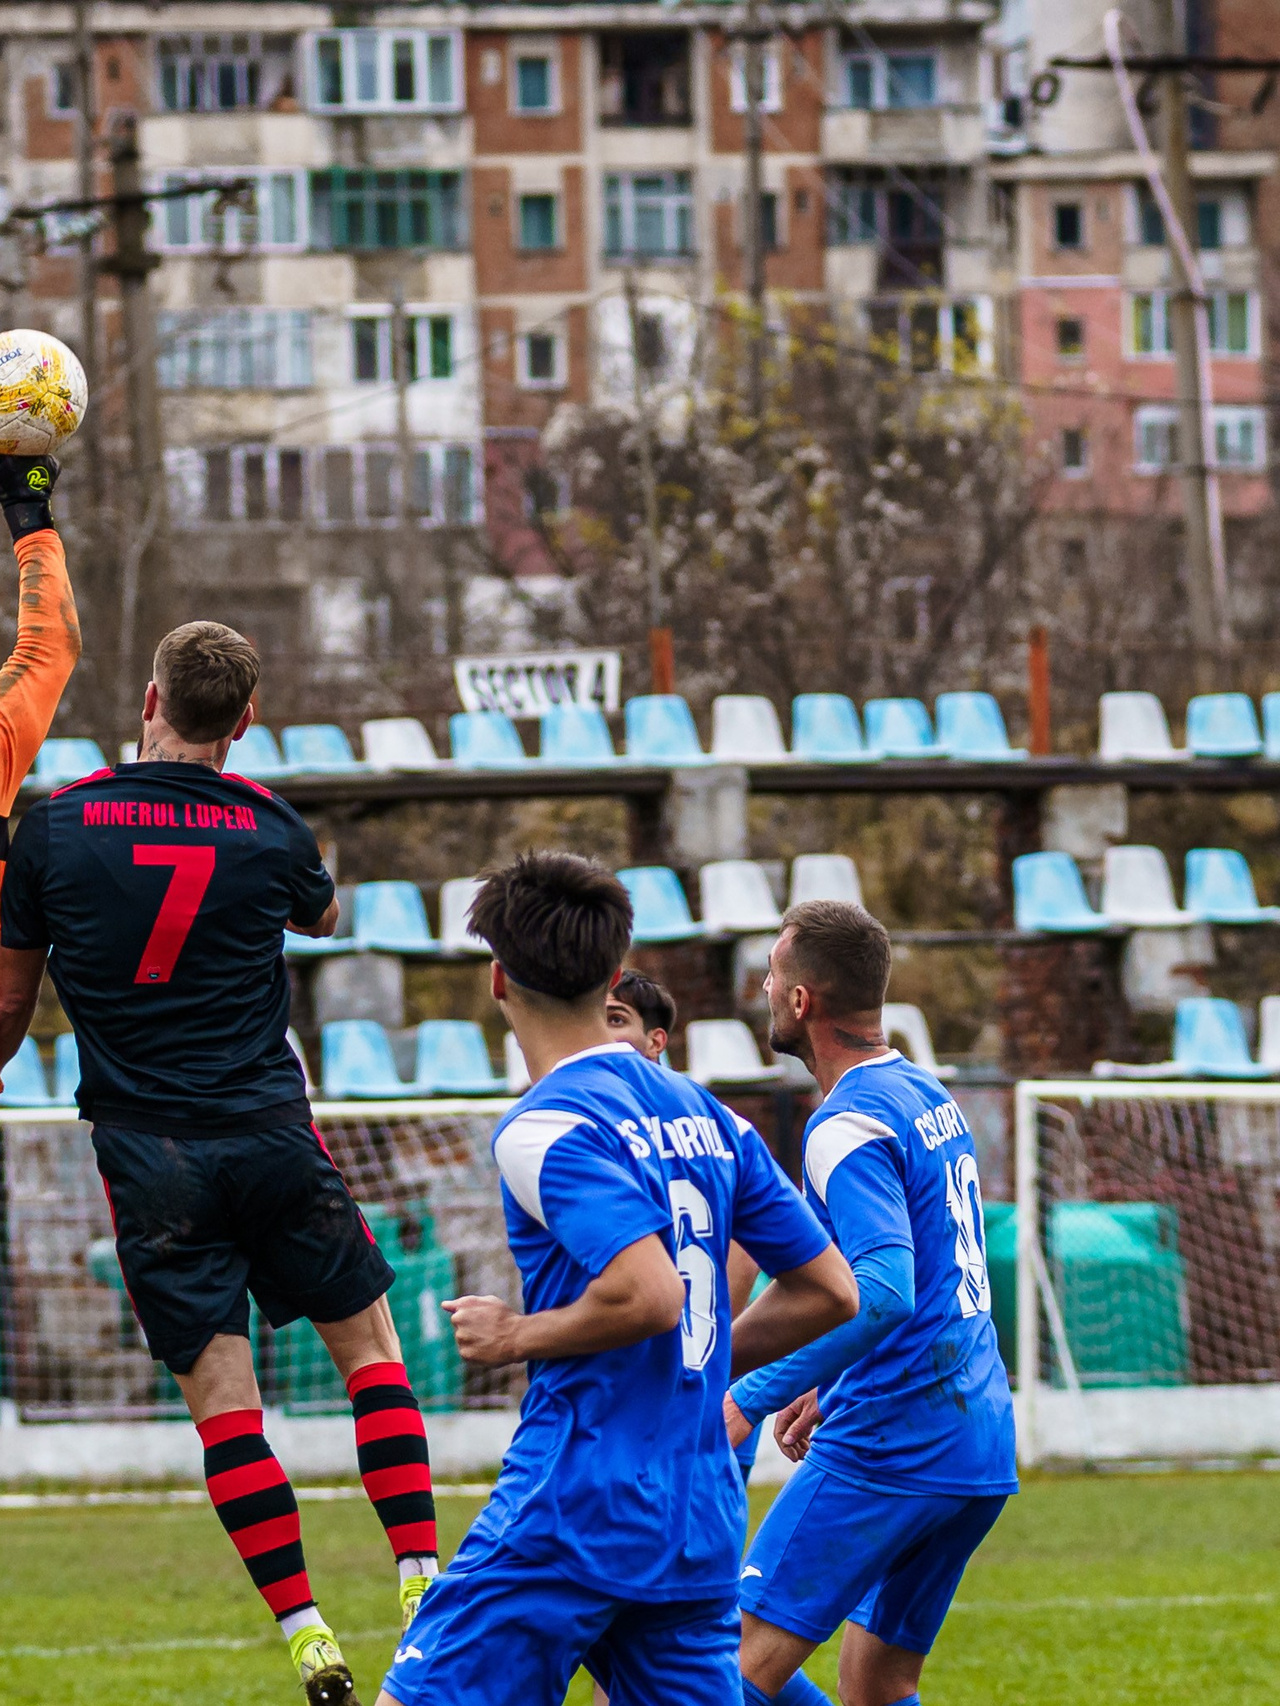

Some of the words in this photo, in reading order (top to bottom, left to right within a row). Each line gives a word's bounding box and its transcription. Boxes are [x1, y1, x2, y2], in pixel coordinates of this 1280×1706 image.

[470, 663, 579, 711] SECTOR
[590, 660, 606, 708] 4
[83, 802, 179, 827] MINERUL
[184, 803, 257, 831] LUPENI
[132, 844, 216, 984] 7
[668, 1178, 717, 1372] 6
[945, 1153, 992, 1320] 10
